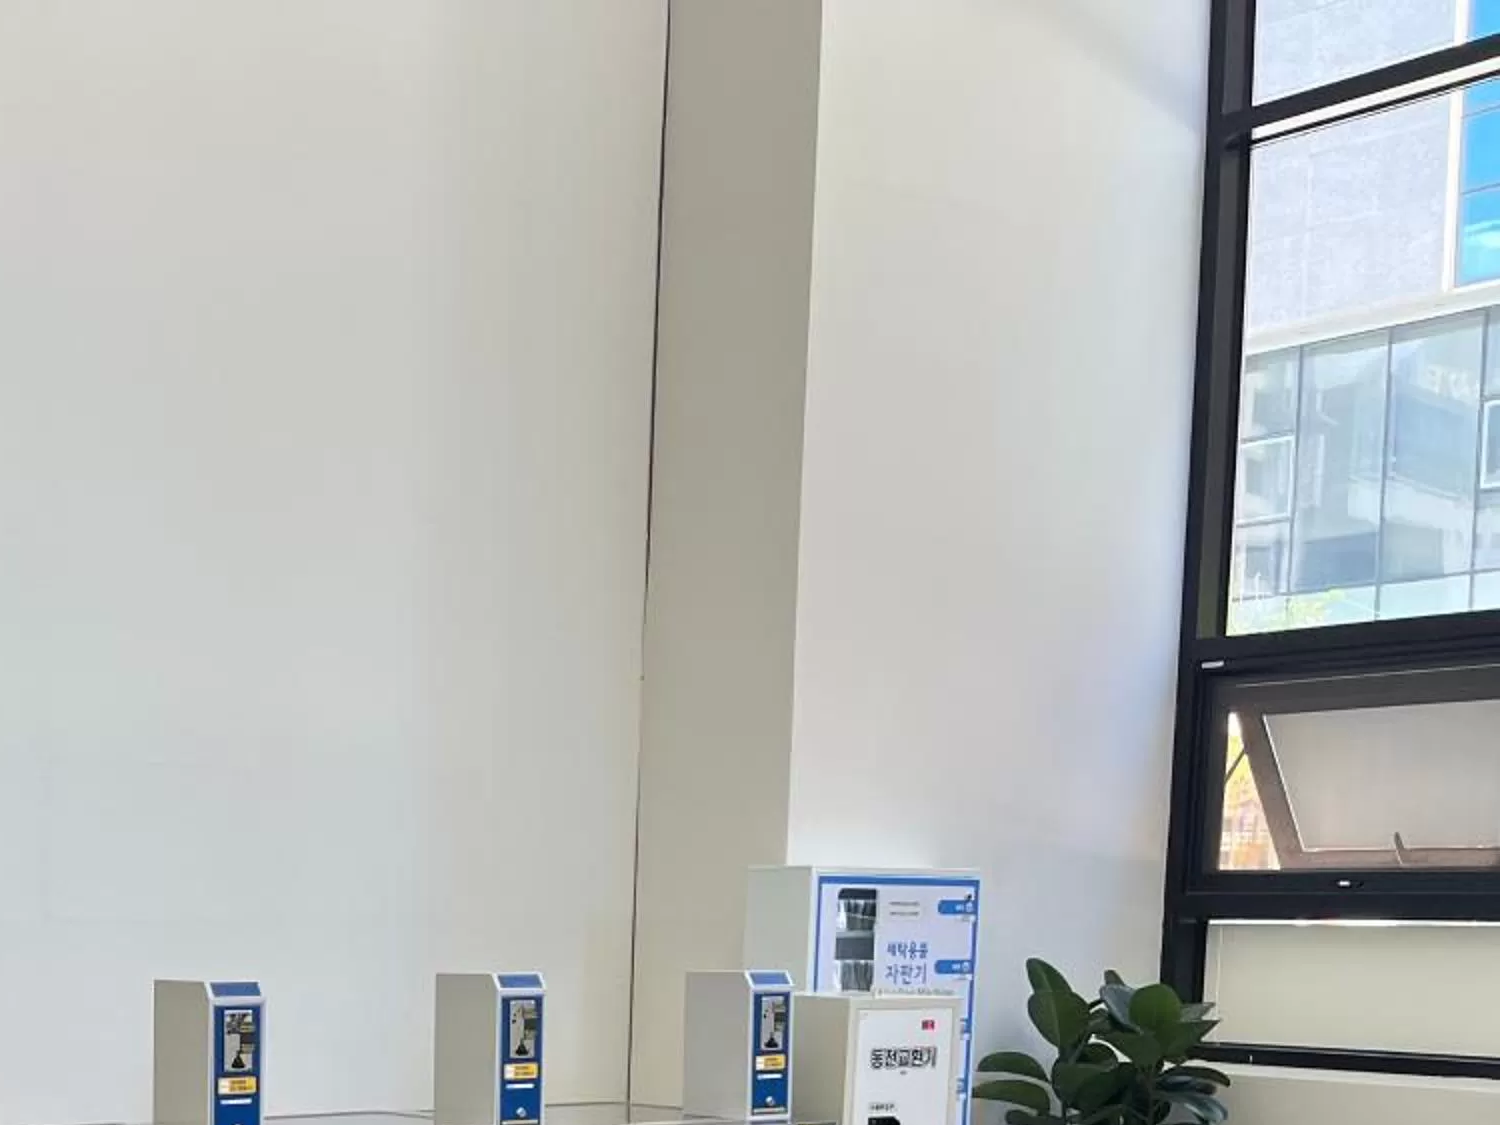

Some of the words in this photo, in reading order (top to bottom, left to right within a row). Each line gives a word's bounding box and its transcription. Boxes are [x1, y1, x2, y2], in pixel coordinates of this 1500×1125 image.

[887, 941, 928, 959] 세탁용품
[885, 962, 928, 985] 자판기
[871, 1046, 938, 1069] 동전교환기
